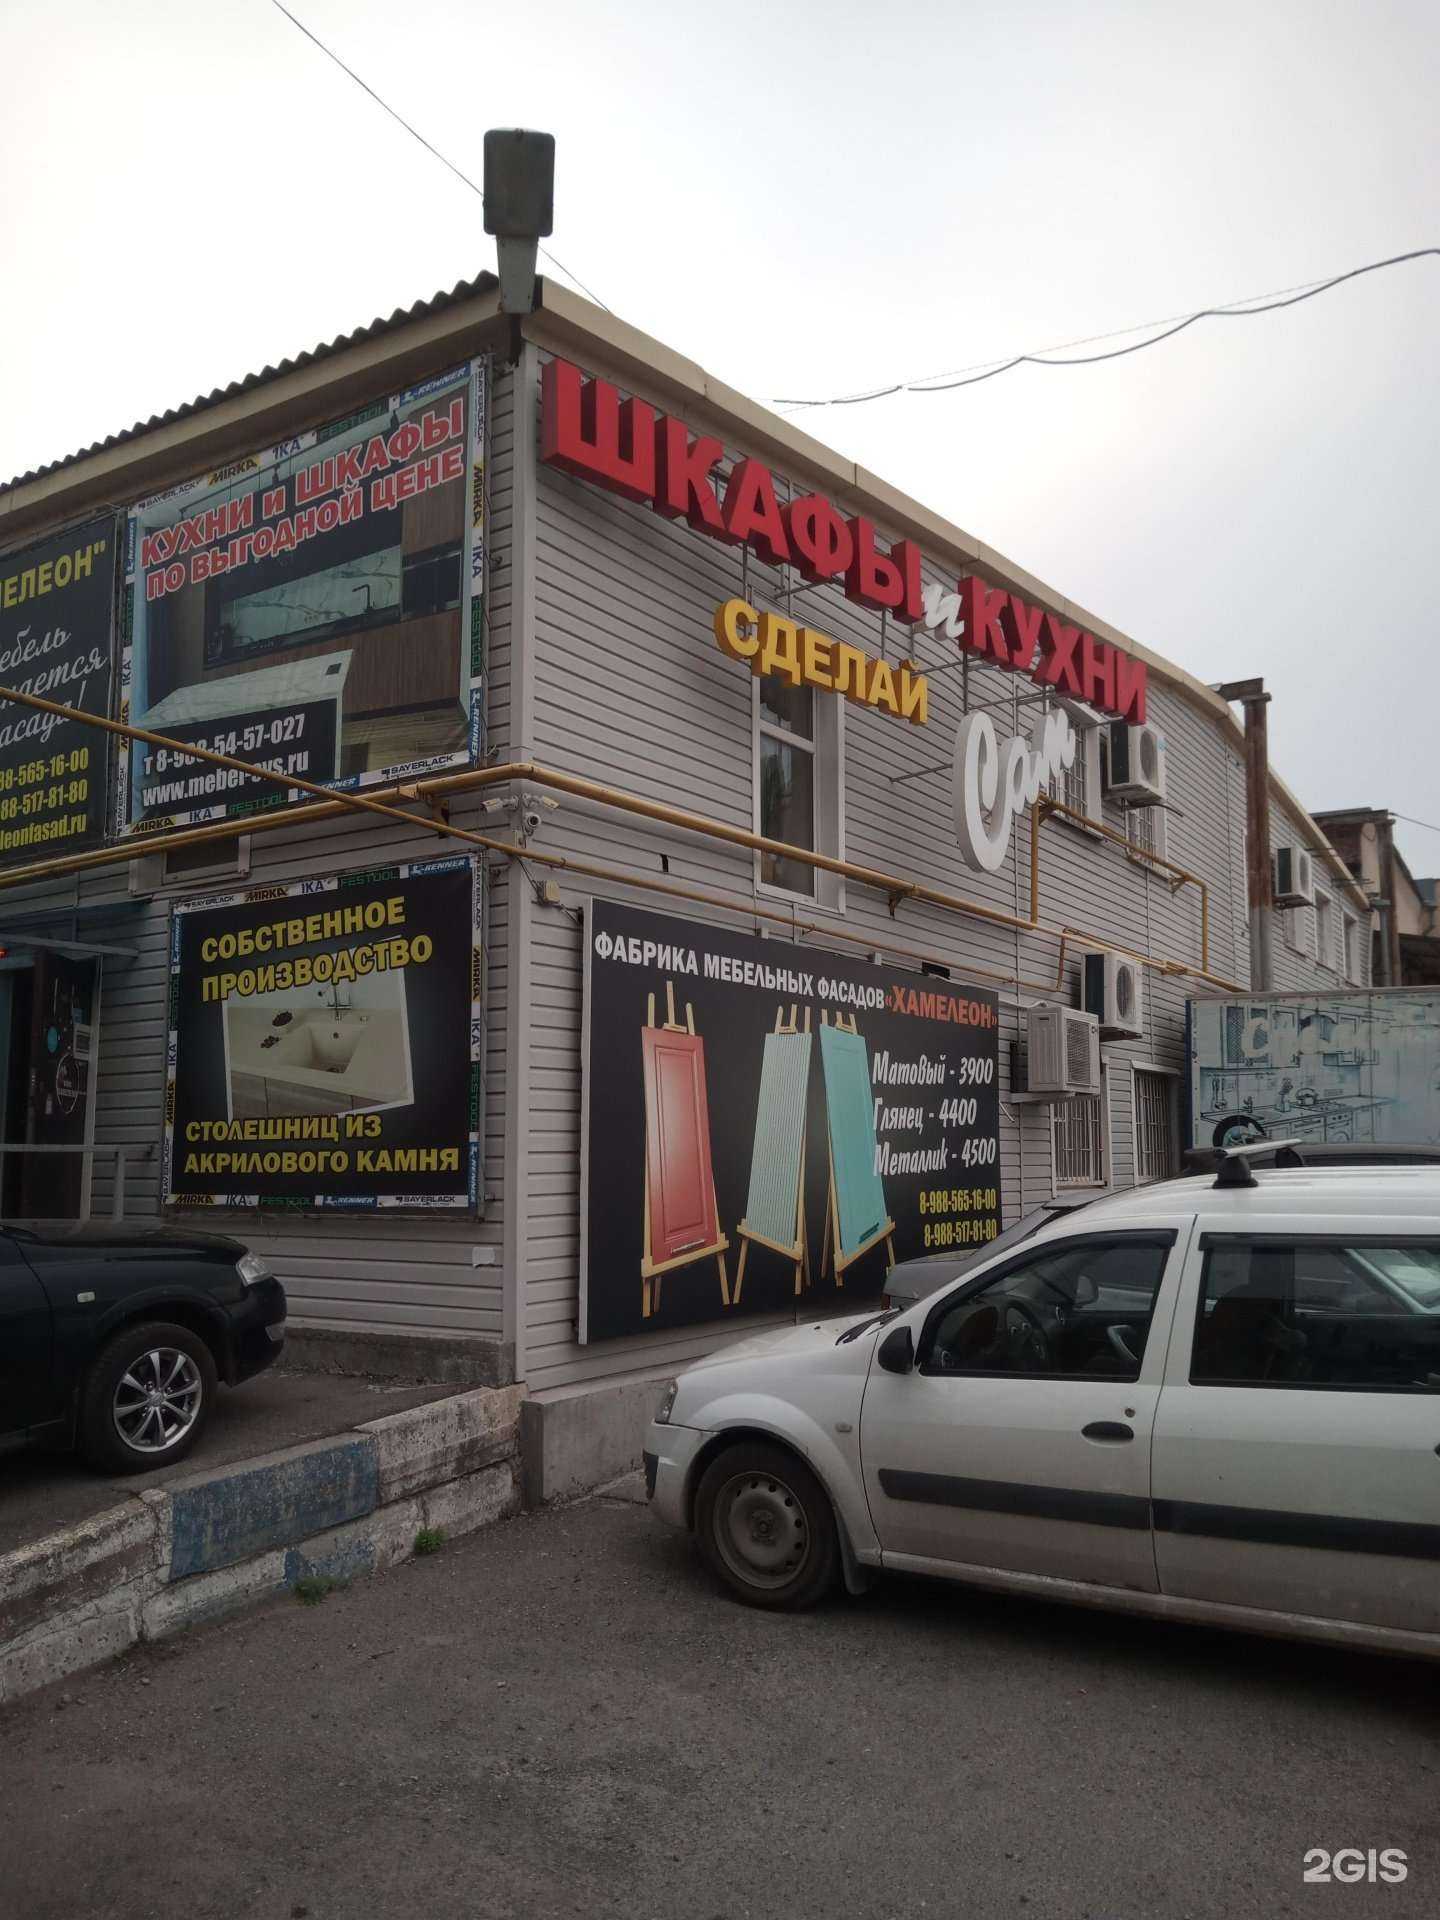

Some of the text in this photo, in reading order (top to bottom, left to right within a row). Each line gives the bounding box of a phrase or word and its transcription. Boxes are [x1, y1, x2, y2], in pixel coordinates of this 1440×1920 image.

[141, 491, 253, 568] КУХНИ
[296, 397, 464, 506] ШКАФЫ
[208, 458, 258, 486] MIRKA
[473, 465, 483, 527] MIRKA
[146, 443, 464, 601] ПО ВЫГОДНОЙ ЦЕНЕ
[542, 358, 923, 625] ШКАФЫ
[958, 575, 1147, 726] КУХНИ
[0, 540, 106, 608] ЕЛЕОН"
[472, 546, 482, 577] IKA
[714, 598, 928, 725] СДЕЛАЙ
[391, 753, 456, 774] SAYERLACK
[131, 817, 175, 833] MIRKA
[189, 809, 212, 822] IKA
[244, 887, 287, 902] MIRKA
[301, 881, 325, 893] IKA
[202, 896, 406, 962] СОБСТВЕННОЕ
[202, 934, 433, 1002] ПРОИЗВОДСТВО
[472, 948, 481, 1000] MIRKA
[594, 931, 998, 1028] ФАБРИКА МЕБЕЛЬНЫХ ФАСАДОВ «ХАМЕЛЕОН»
[471, 1018, 480, 1045] IKA
[873, 1051, 946, 1085] Матовый
[959, 1057, 993, 1085] 3900
[185, 1115, 382, 1142] СТОЛЕШНИЦ ИЗ
[873, 1097, 923, 1135] Глянец
[939, 1098, 977, 1128] 4400
[184, 1151, 349, 1173] АКРИЛОВОГО
[357, 1148, 459, 1172] КАМНЯ
[874, 1138, 948, 1177] Металлик
[961, 1138, 996, 1168] 4500
[225, 1195, 246, 1206] IKA
[919, 1188, 996, 1215] 8-988-565-16-00
[924, 1218, 997, 1248] 8-988-517-81-80
